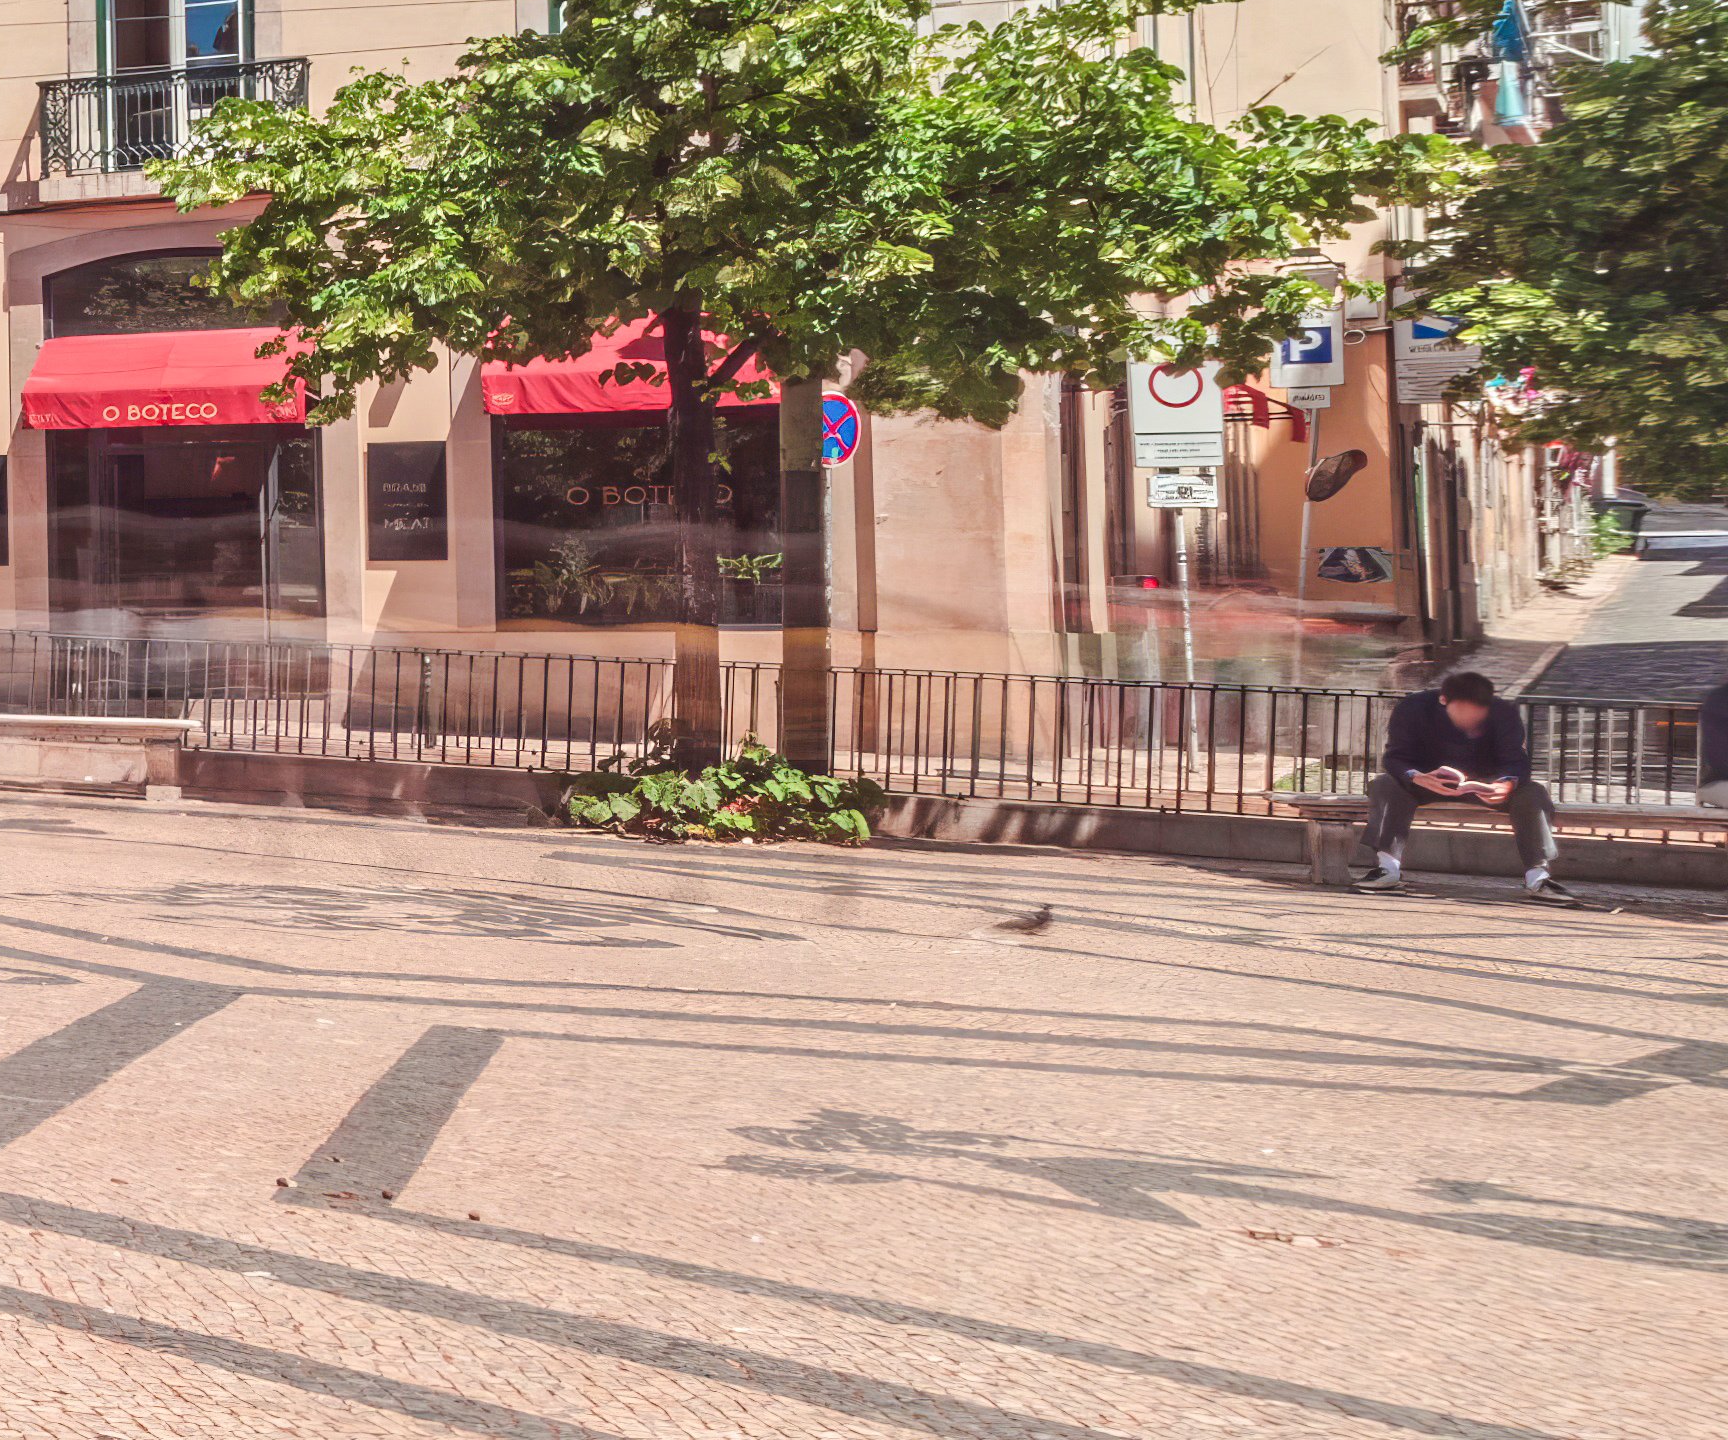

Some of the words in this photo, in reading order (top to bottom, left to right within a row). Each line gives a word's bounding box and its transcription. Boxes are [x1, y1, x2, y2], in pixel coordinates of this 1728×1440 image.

[102, 405, 121, 422] O
[127, 402, 218, 421] BOTECO
[566, 486, 590, 506] O
[602, 485, 733, 506] BOTO
